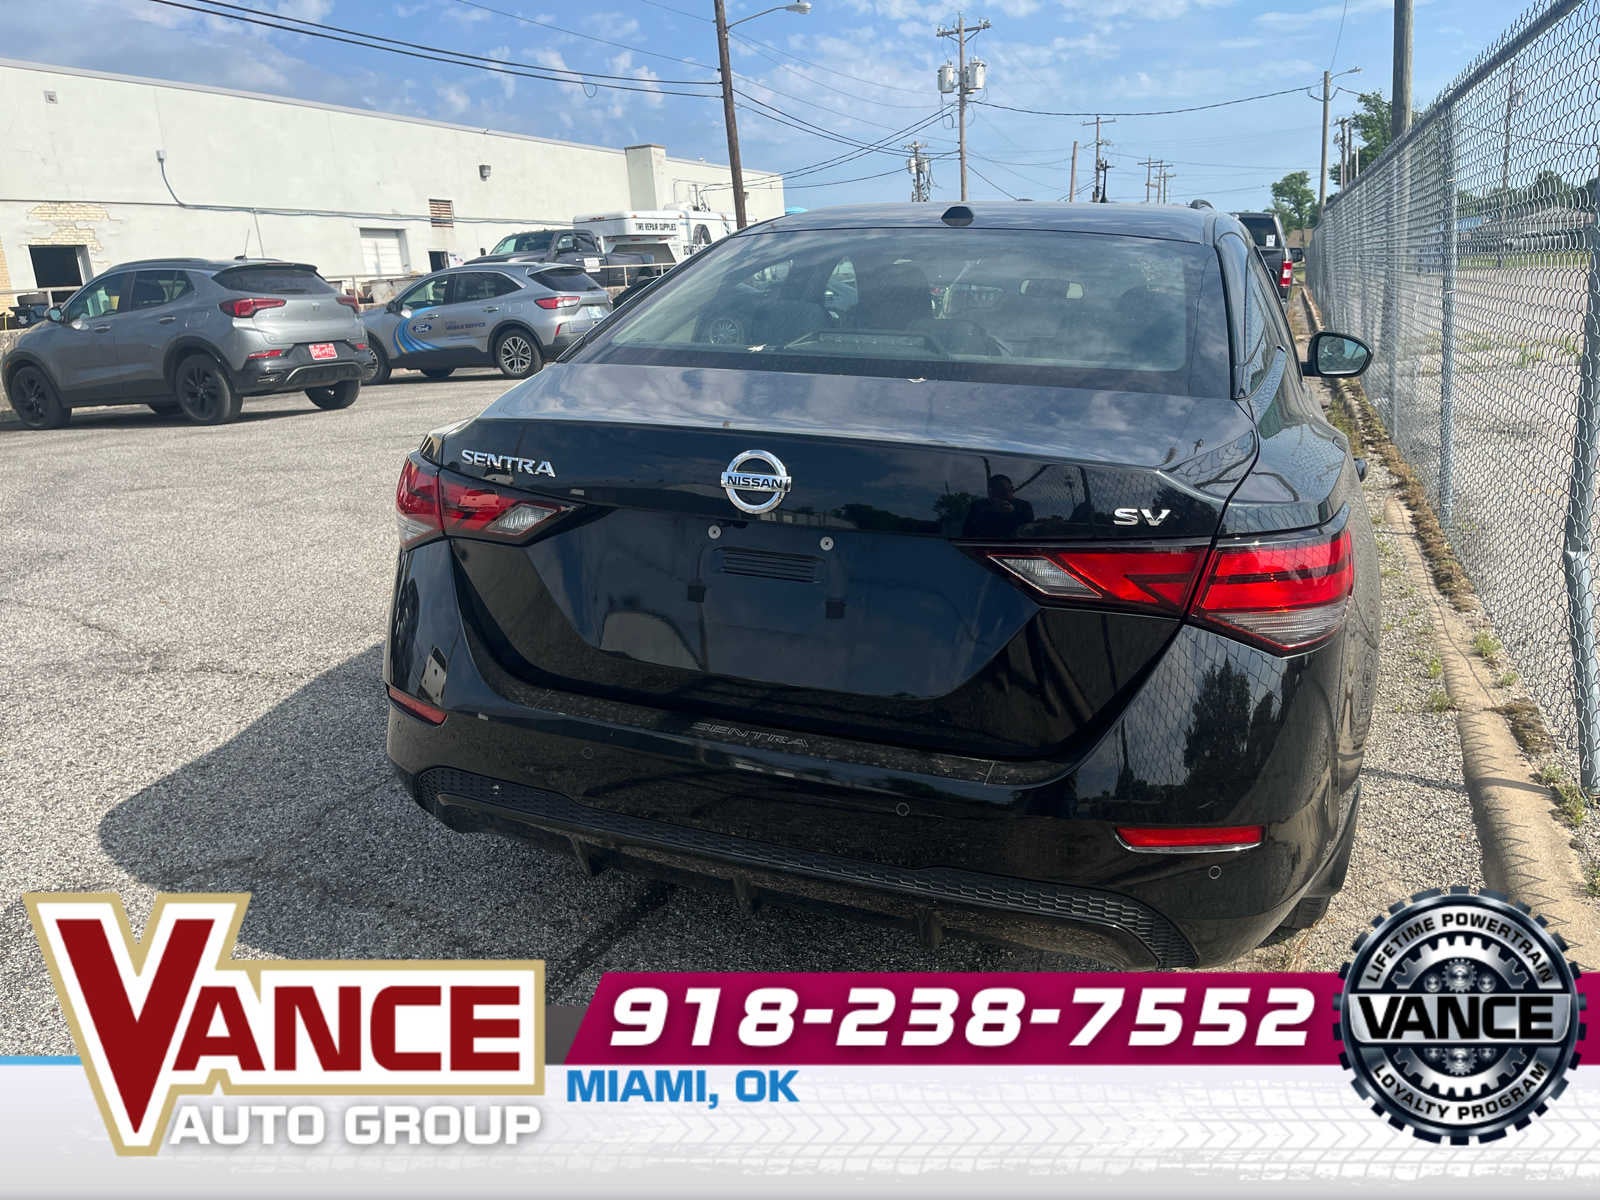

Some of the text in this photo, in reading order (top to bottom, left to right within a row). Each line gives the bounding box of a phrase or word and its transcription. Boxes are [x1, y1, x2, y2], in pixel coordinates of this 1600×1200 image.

[461, 449, 556, 478] SENTRA
[727, 475, 783, 489] NISSAN
[1113, 508, 1171, 526] SV
[690, 721, 809, 751] SENTRA
